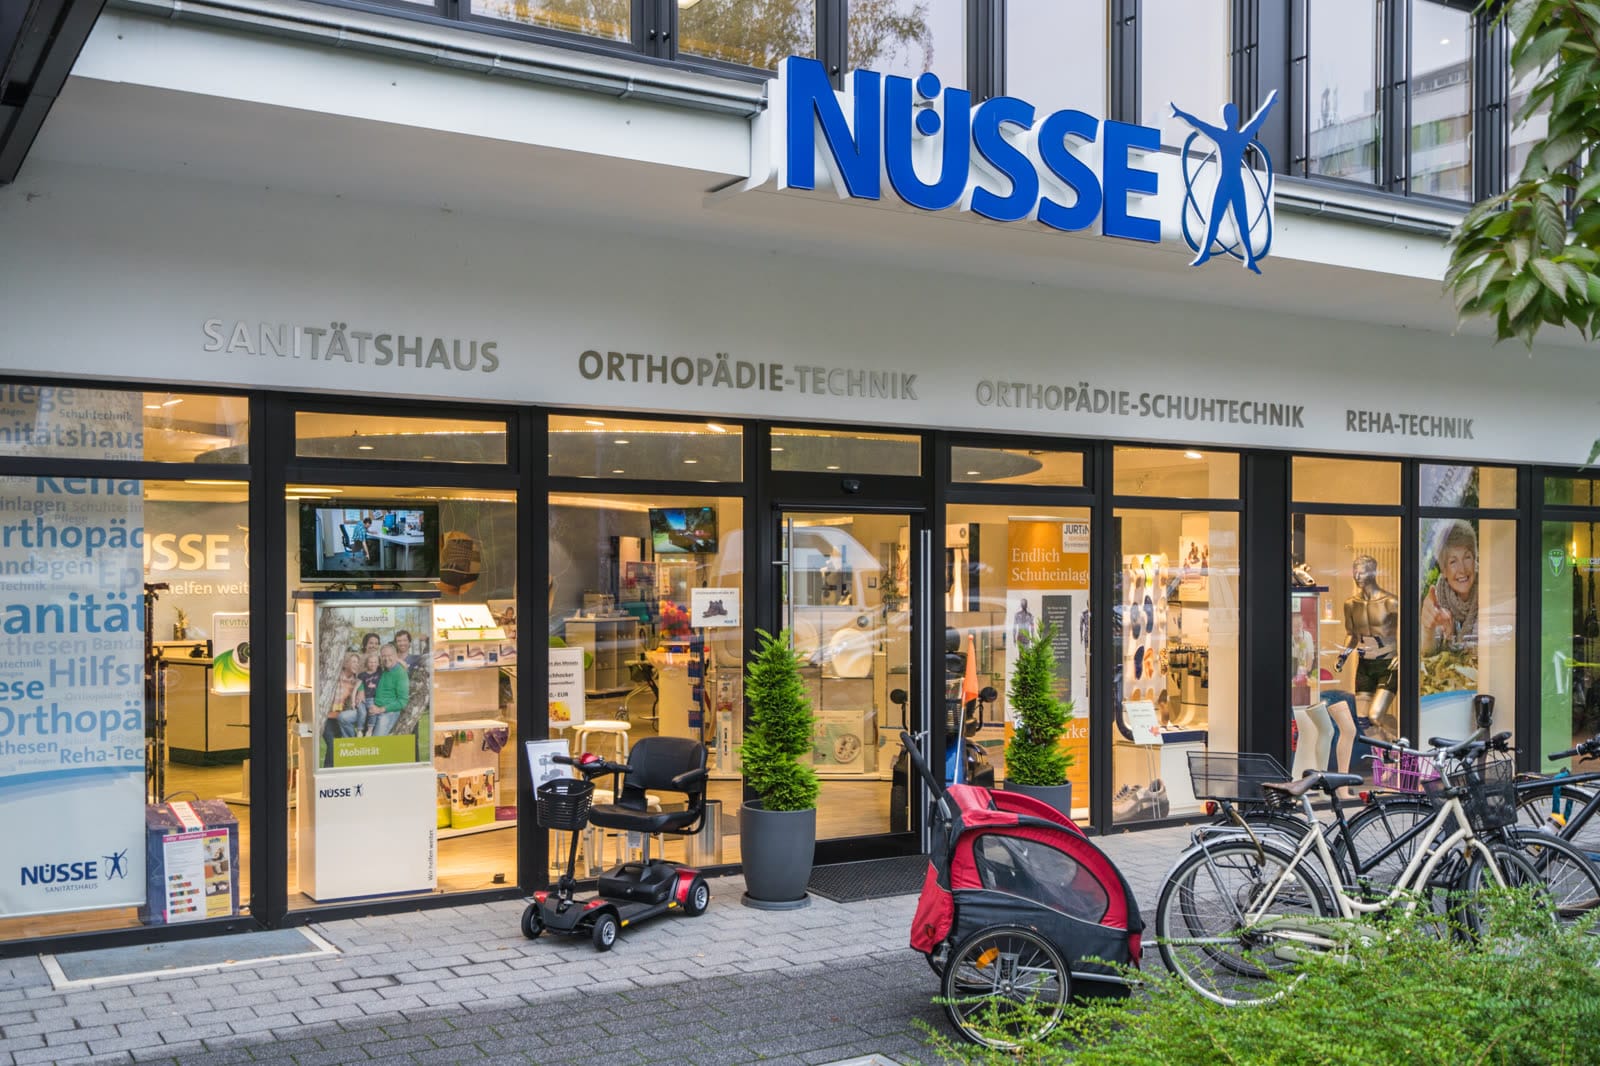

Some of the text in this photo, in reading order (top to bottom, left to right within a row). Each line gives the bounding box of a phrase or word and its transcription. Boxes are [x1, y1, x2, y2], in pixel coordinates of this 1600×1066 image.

[785, 56, 1162, 244] NÜSSE
[202, 318, 499, 373] SANITÄTSHAUS
[578, 350, 919, 401] ORTHOPÄDIE-TECHNIK
[975, 380, 1305, 428] ORTHOPÄDIE-SCHUHTECHNIK
[1346, 409, 1475, 440] REHA-TECHNIK
[1012, 547, 1061, 563] Endlich
[0, 591, 143, 635] anität
[339, 746, 380, 758] Mobilität
[319, 788, 351, 799] NÜSSE
[21, 861, 98, 886] NÜSSE
